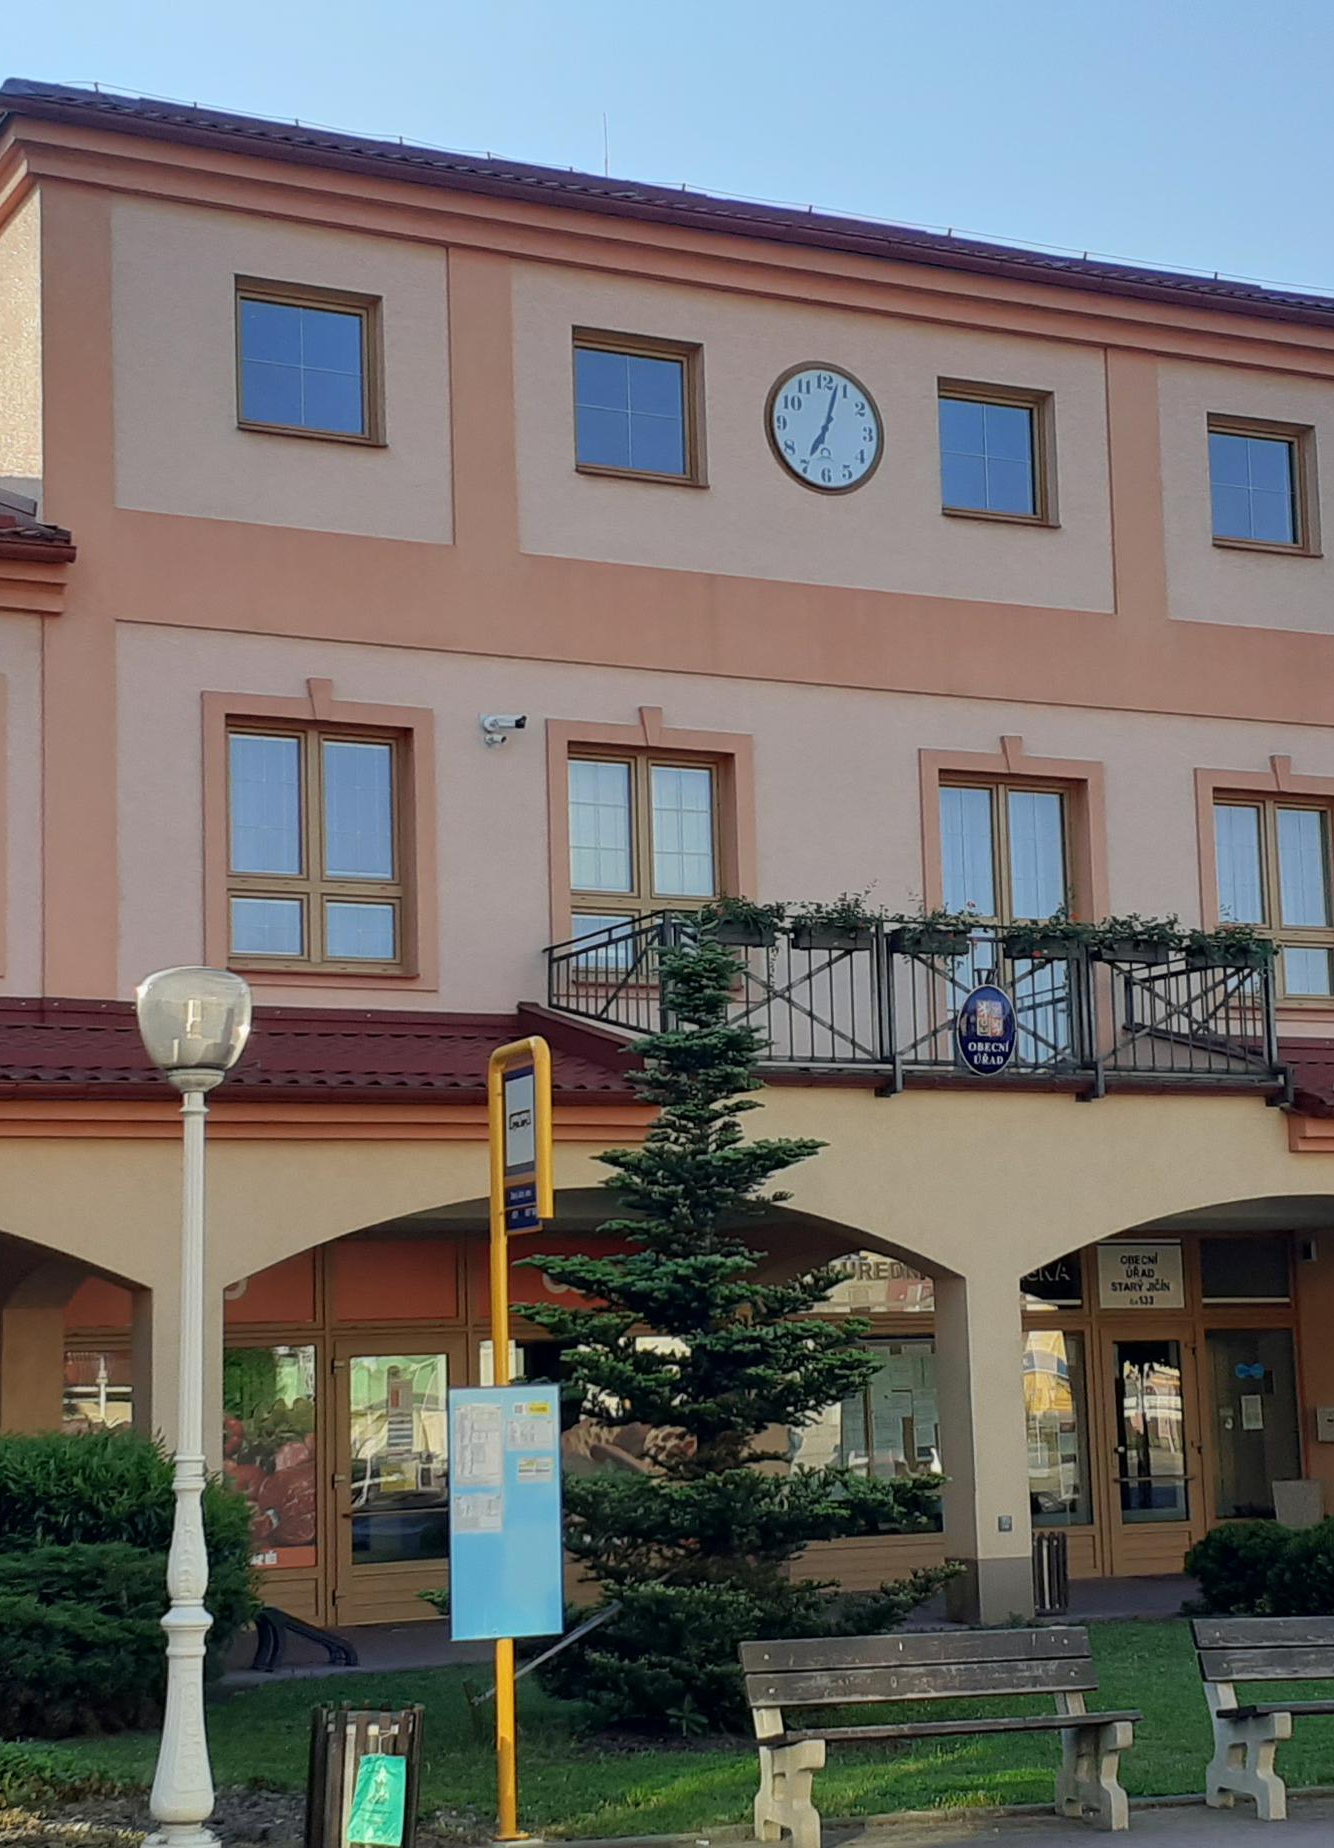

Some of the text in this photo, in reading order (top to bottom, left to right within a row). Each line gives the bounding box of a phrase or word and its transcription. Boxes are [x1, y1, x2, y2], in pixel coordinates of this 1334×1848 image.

[798, 378, 811, 395] 11
[817, 372, 834, 391] 12
[842, 384, 848, 399] 1
[783, 394, 802, 411] 10
[854, 401, 866, 417] 2
[776, 415, 788, 431] 9
[862, 427, 873, 442] 3
[784, 439, 796, 456] 8
[855, 449, 866, 464] 4
[799, 458, 810, 474] 7
[842, 464, 853, 480] 5
[820, 467, 832, 483] 6
[968, 1040, 1009, 1053] OBECNÍ
[973, 1053, 1004, 1065] ÚŘAD
[1120, 1252, 1158, 1265] OBECNÍ
[1126, 1265, 1155, 1278] ÚŘAD
[1111, 1278, 1171, 1292] STARÝ JIČÍN
